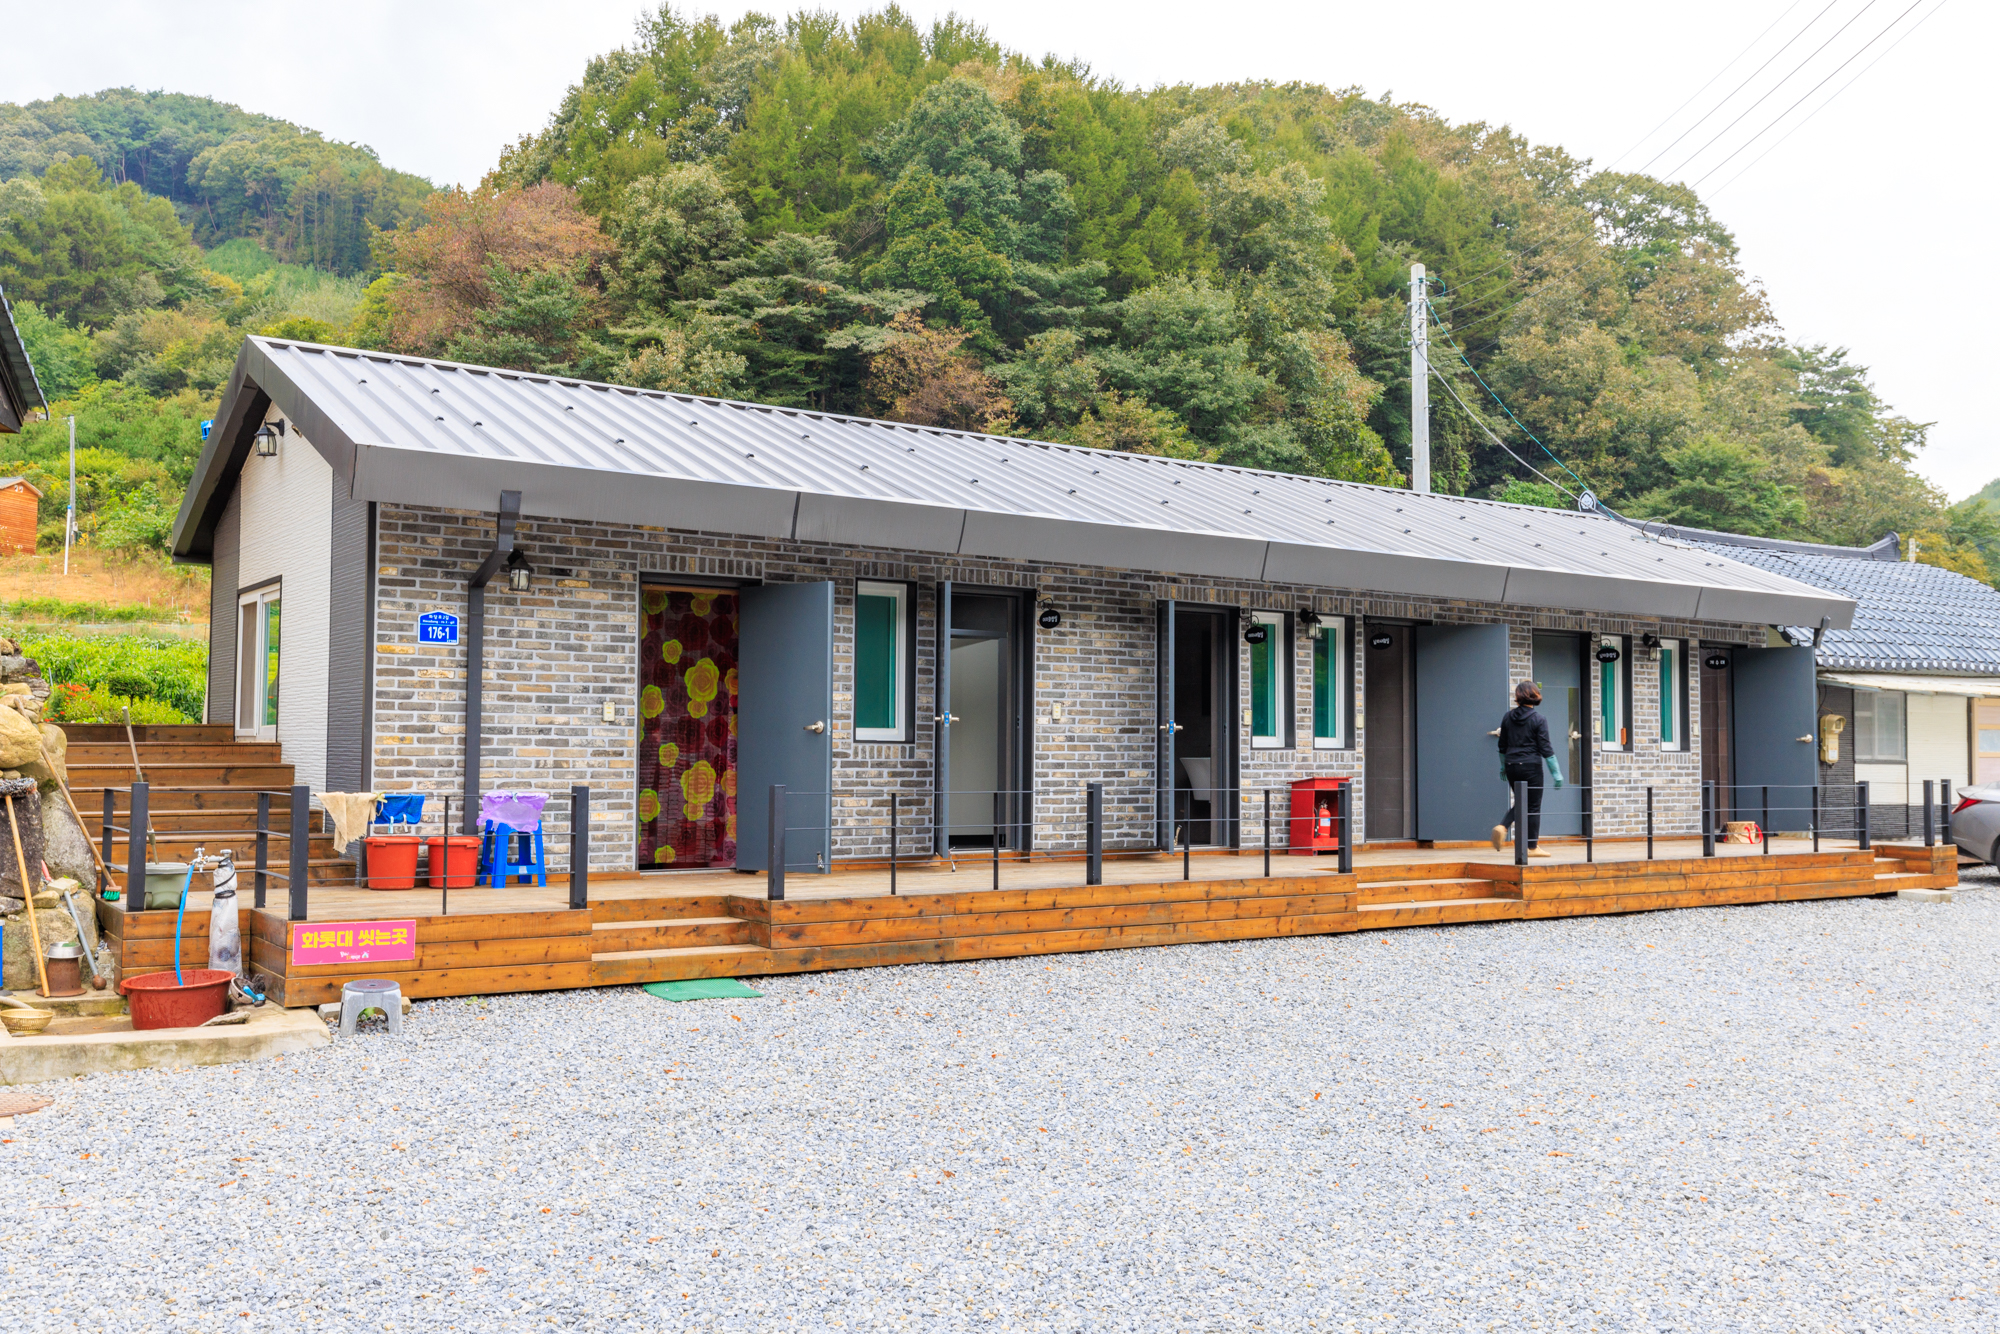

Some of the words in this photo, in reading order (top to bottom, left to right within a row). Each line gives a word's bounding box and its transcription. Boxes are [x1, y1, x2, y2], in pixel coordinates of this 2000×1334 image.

[428, 626, 450, 640] 176-1
[301, 930, 353, 949] 화롯대
[358, 928, 408, 947] 씻는곳
